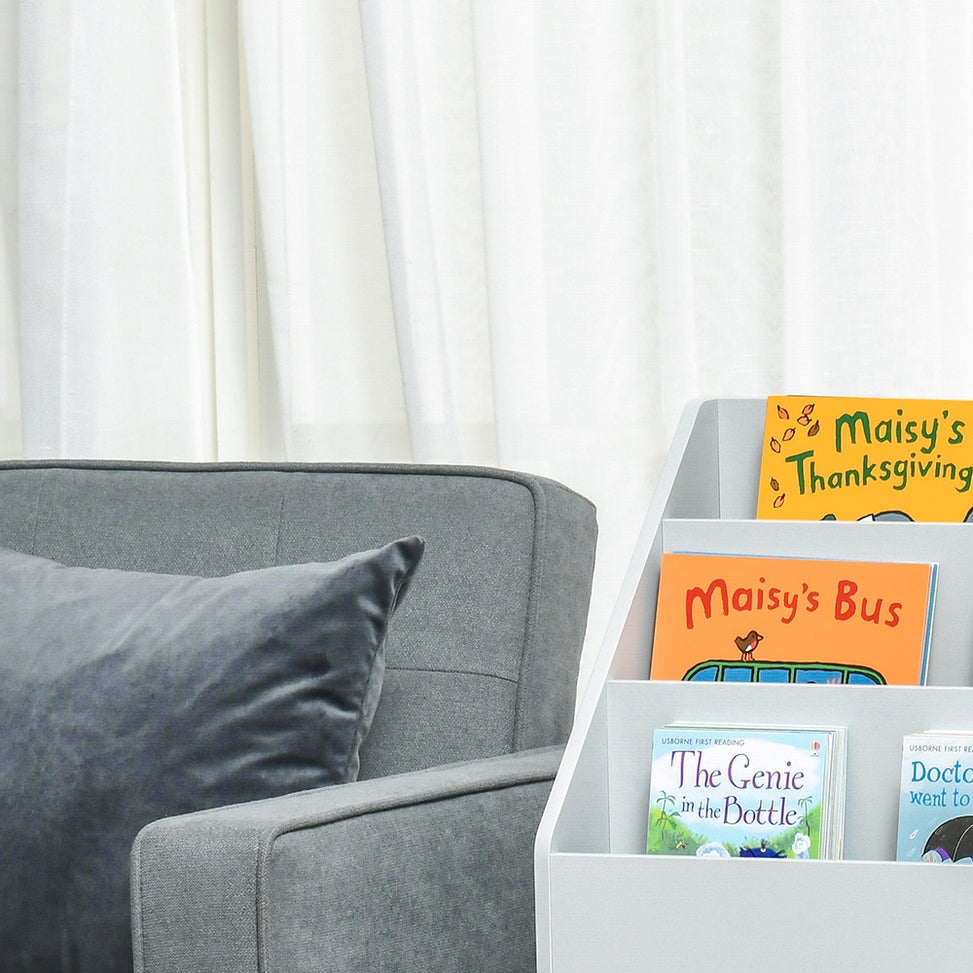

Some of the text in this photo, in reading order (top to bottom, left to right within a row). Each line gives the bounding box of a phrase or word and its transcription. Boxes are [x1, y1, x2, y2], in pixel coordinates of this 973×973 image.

[835, 409, 966, 454] Maisy's
[785, 450, 973, 495] Thanksgiving
[685, 577, 902, 629] Maisy's Bus
[695, 738, 712, 746] FIRST
[714, 738, 745, 746] READING
[909, 744, 942, 752] USBORNE
[944, 745, 961, 753] FIRST
[670, 750, 804, 790] The Genie
[681, 795, 798, 826] in the Bottle
[910, 787, 947, 807] went
[953, 788, 970, 807] to
